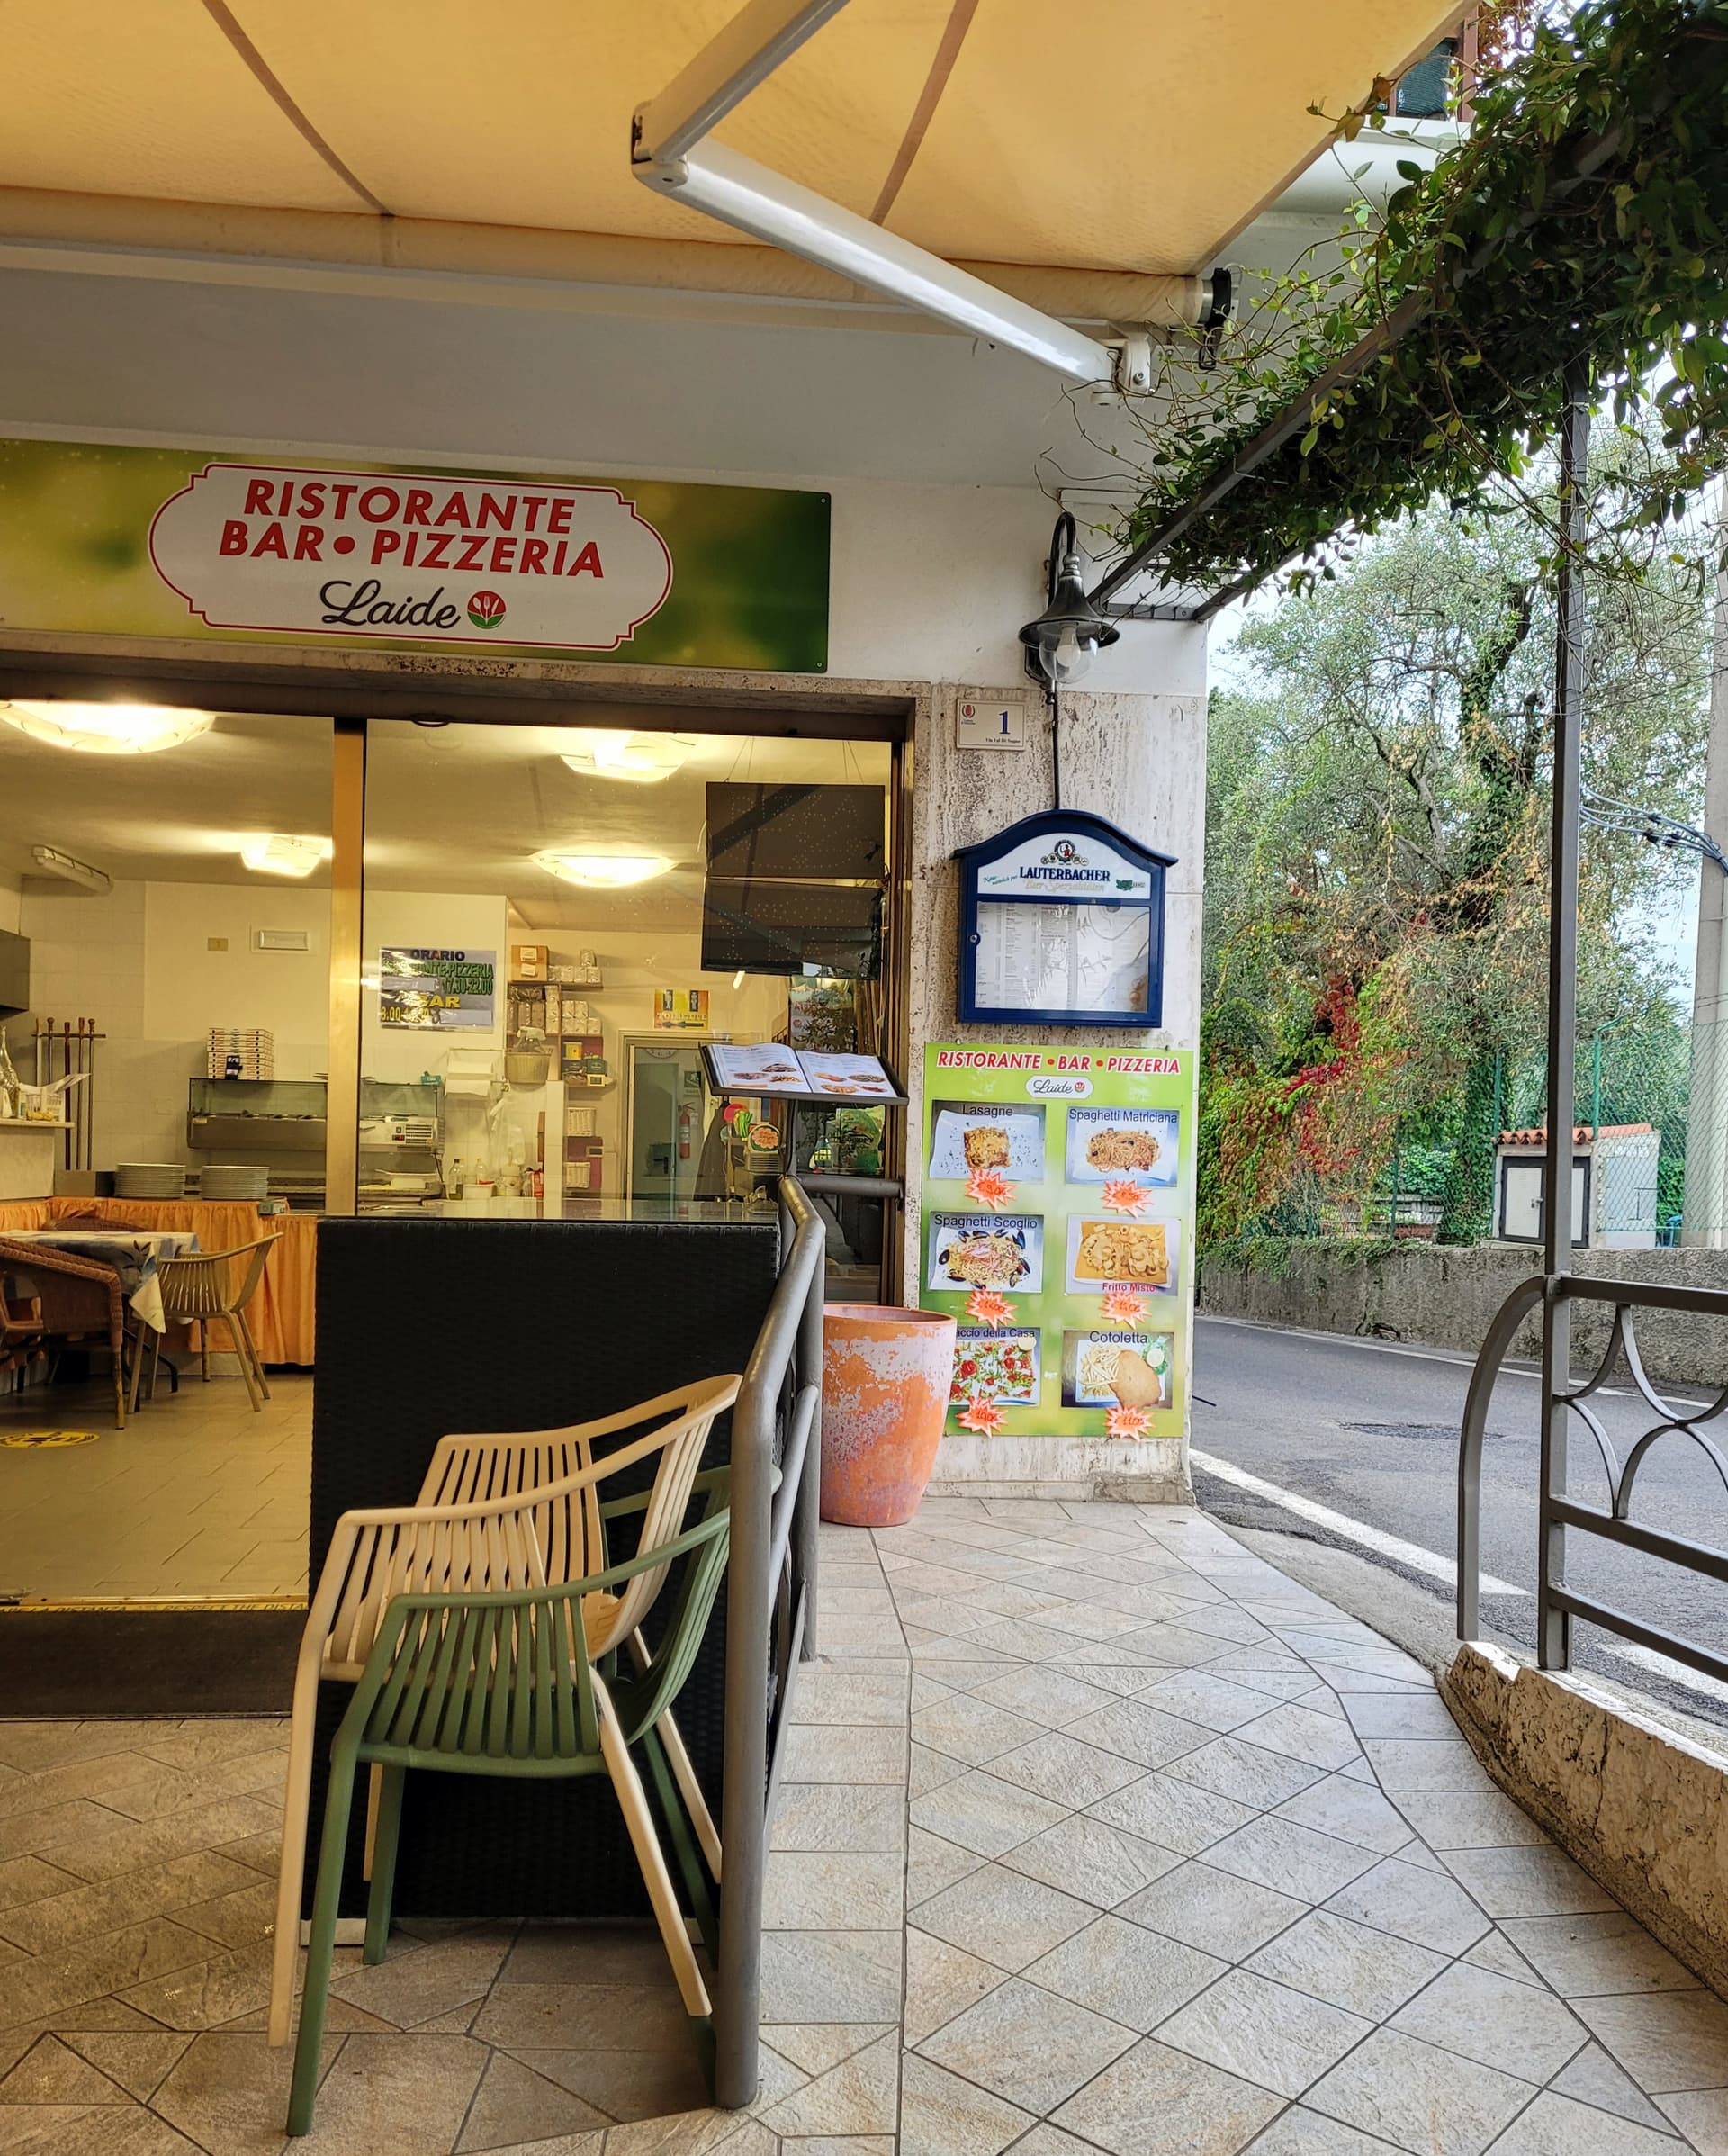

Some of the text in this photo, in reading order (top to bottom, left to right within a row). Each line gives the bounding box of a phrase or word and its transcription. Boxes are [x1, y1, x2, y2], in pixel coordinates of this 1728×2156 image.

[244, 479, 576, 534] RISTORANTE
[219, 520, 604, 578] BAR PIZZERIA
[320, 579, 461, 629] Laide
[998, 710, 1011, 735] 1
[1019, 866, 1111, 882] LAUTERBACHER
[411, 949, 465, 961] ORARIO
[418, 994, 461, 1008] BAR
[937, 1051, 1180, 1074] RISTORANTE BAR PIZZERIA
[1033, 1079, 1074, 1094] Laide
[963, 1104, 1013, 1119] Lasagne
[1069, 1108, 1177, 1123] Spaghetti Matriciana
[934, 1214, 1038, 1231] Spaghetti Scoglio
[1102, 1282, 1156, 1292] Fritto Misto
[956, 1328, 980, 1338] accio
[1009, 1328, 1035, 1338] Casa
[1089, 1331, 1148, 1344] Cotoletta
